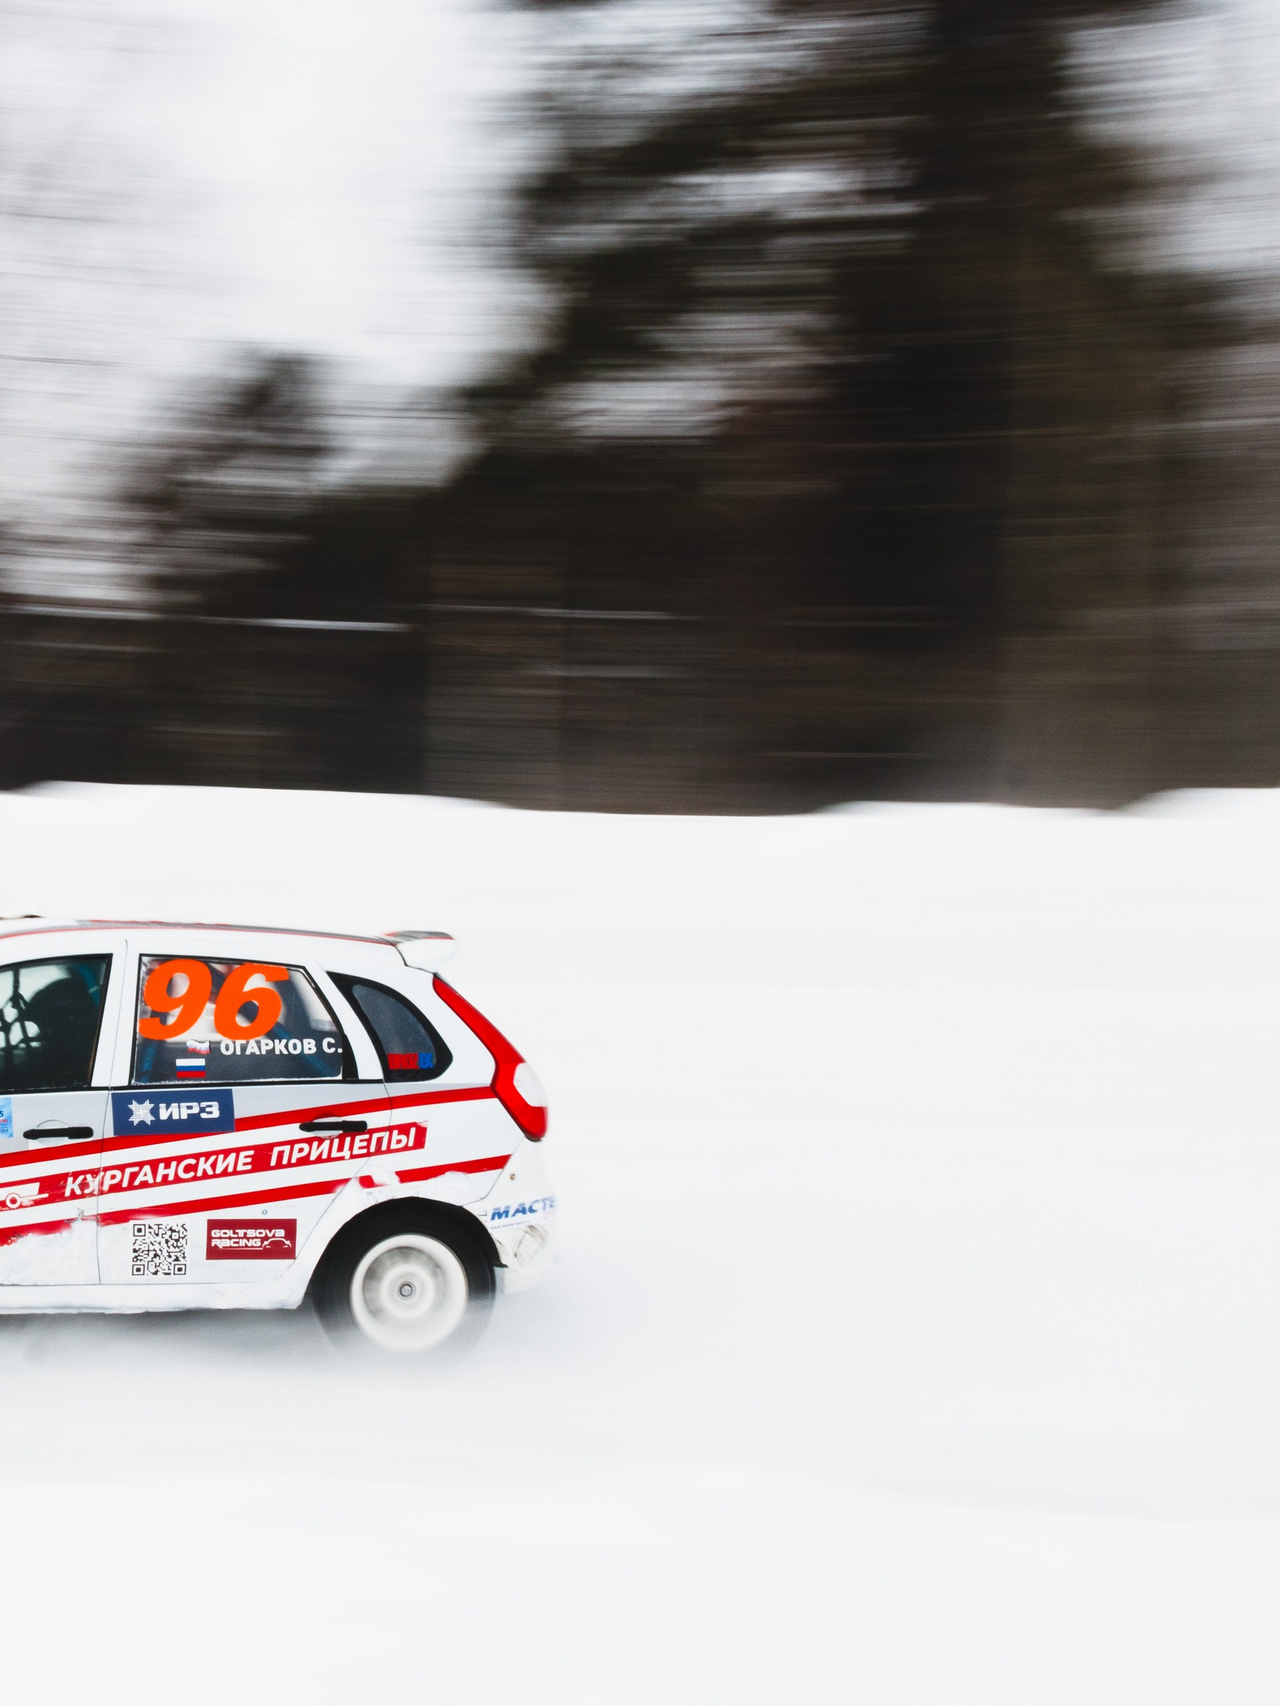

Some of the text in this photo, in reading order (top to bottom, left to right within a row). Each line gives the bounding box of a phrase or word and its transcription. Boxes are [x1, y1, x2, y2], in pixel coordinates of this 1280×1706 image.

[138, 958, 290, 1041] 96
[220, 1037, 343, 1056] ОГАРКОВ С.
[158, 1101, 220, 1121] ИРЗ
[63, 1126, 417, 1197] КУРГАНСКИЕ ПРИЦЕПЫ
